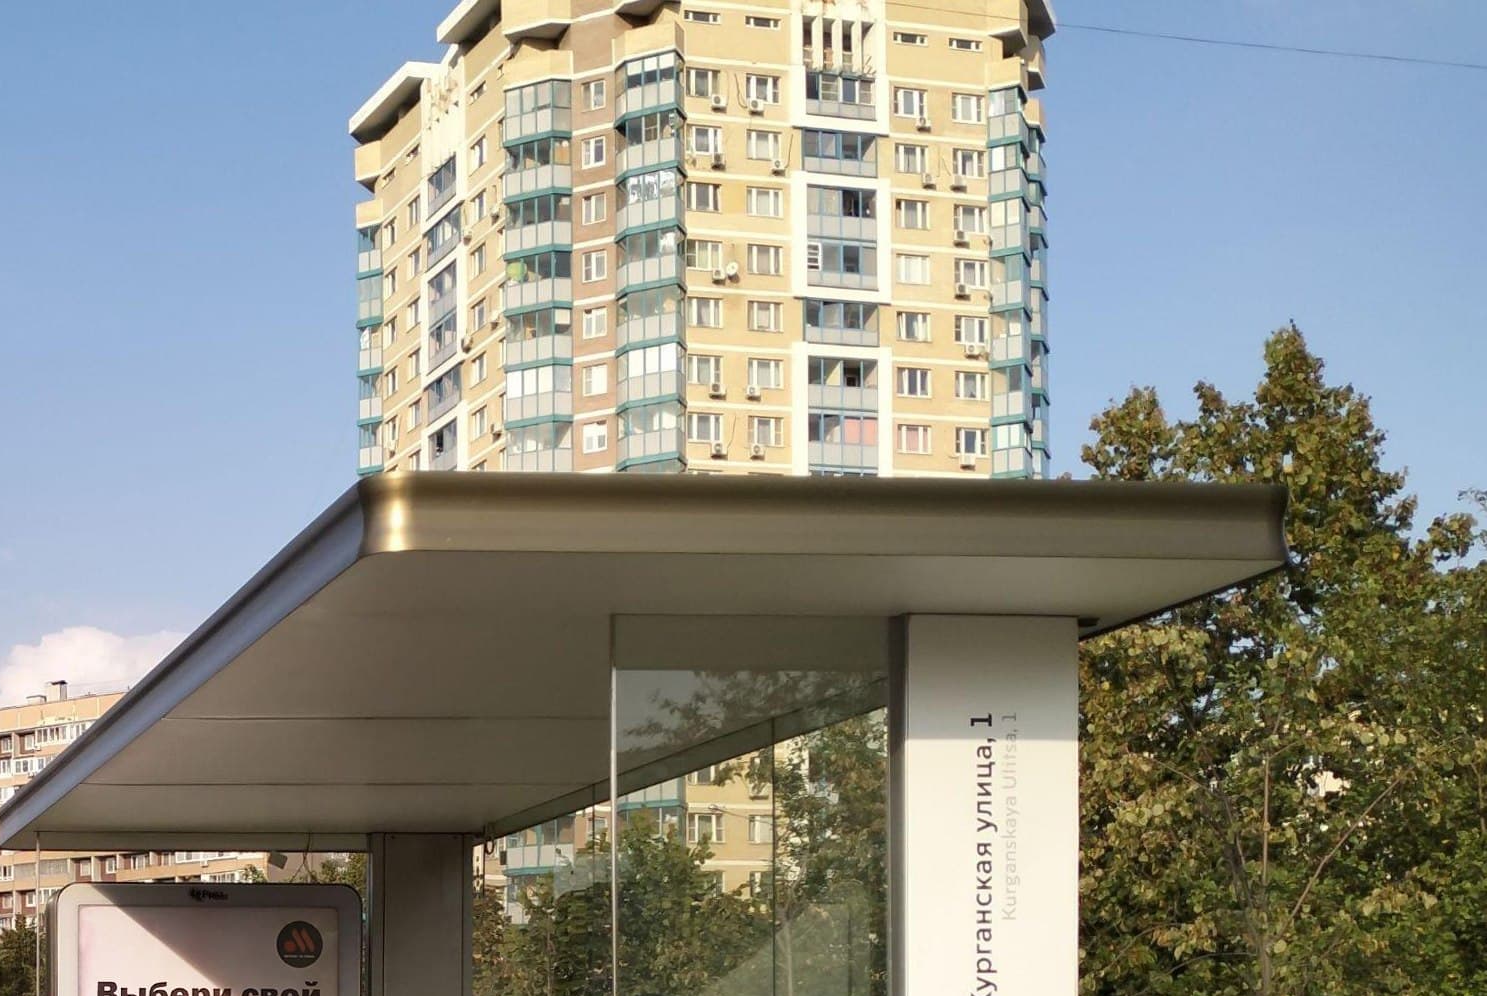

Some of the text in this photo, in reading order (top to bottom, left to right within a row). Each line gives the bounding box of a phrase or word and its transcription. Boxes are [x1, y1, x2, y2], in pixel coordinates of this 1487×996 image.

[970, 712, 993, 727] 1
[976, 736, 998, 832] улица,
[1001, 712, 1021, 920] Kurganskaya Ulitsa, 1
